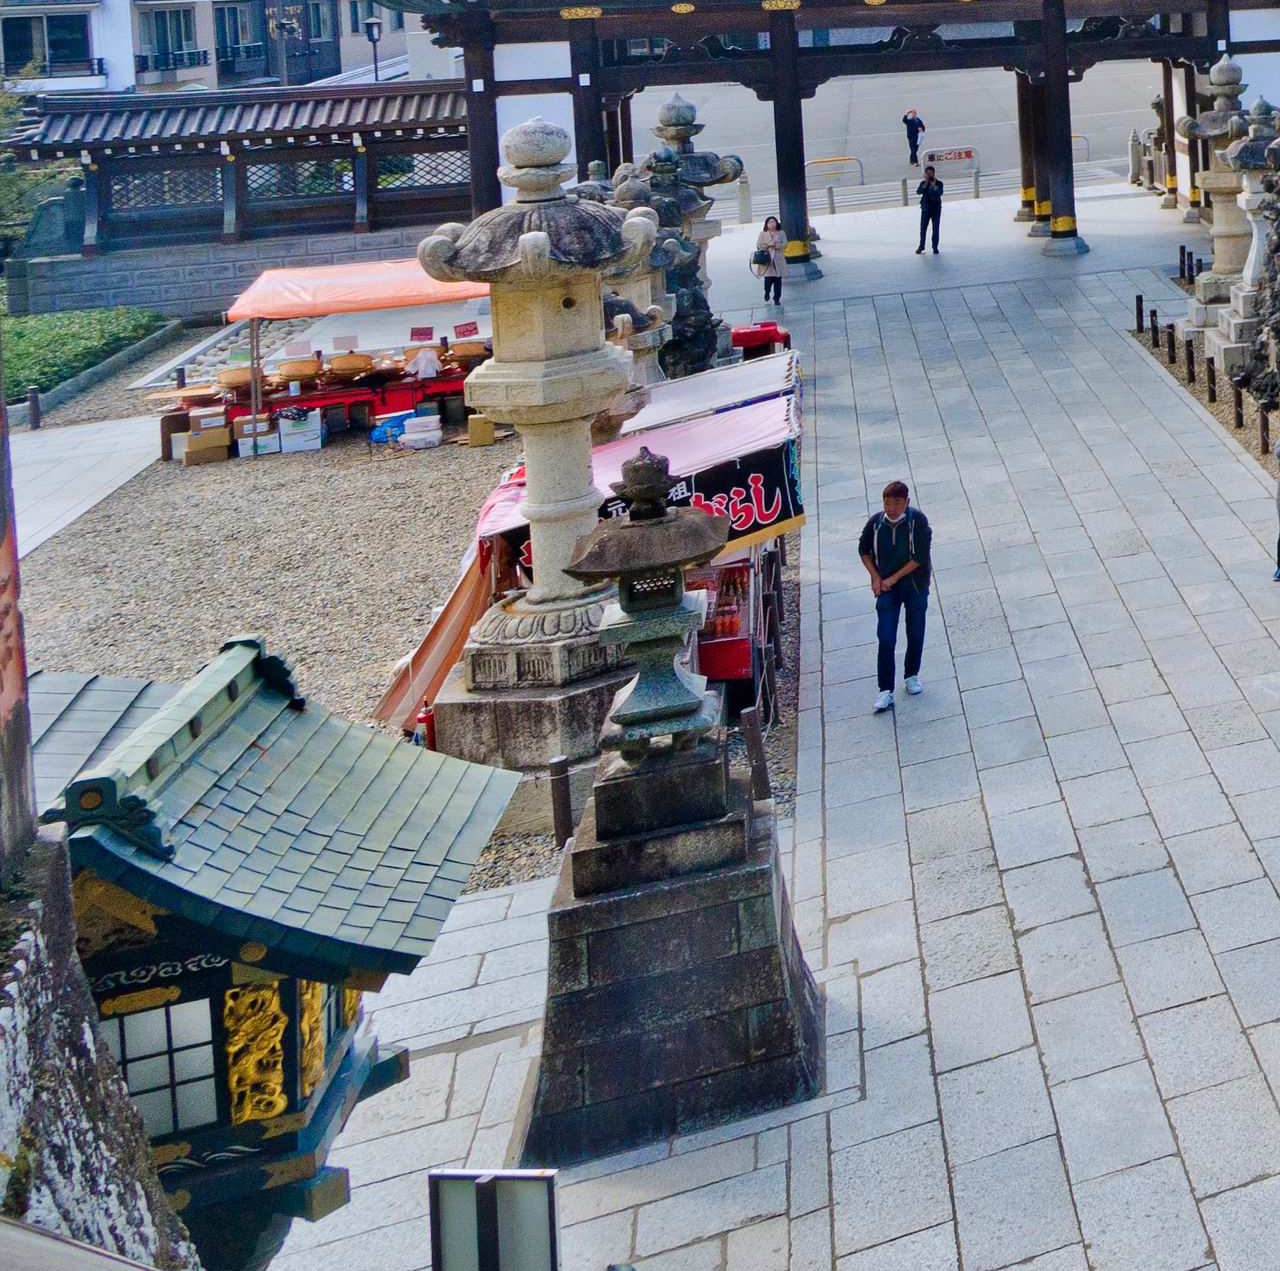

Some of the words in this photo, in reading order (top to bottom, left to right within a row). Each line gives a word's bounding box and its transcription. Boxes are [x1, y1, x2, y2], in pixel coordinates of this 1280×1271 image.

[928, 150, 974, 163] 車にご注意
[606, 480, 692, 519] 元祖
